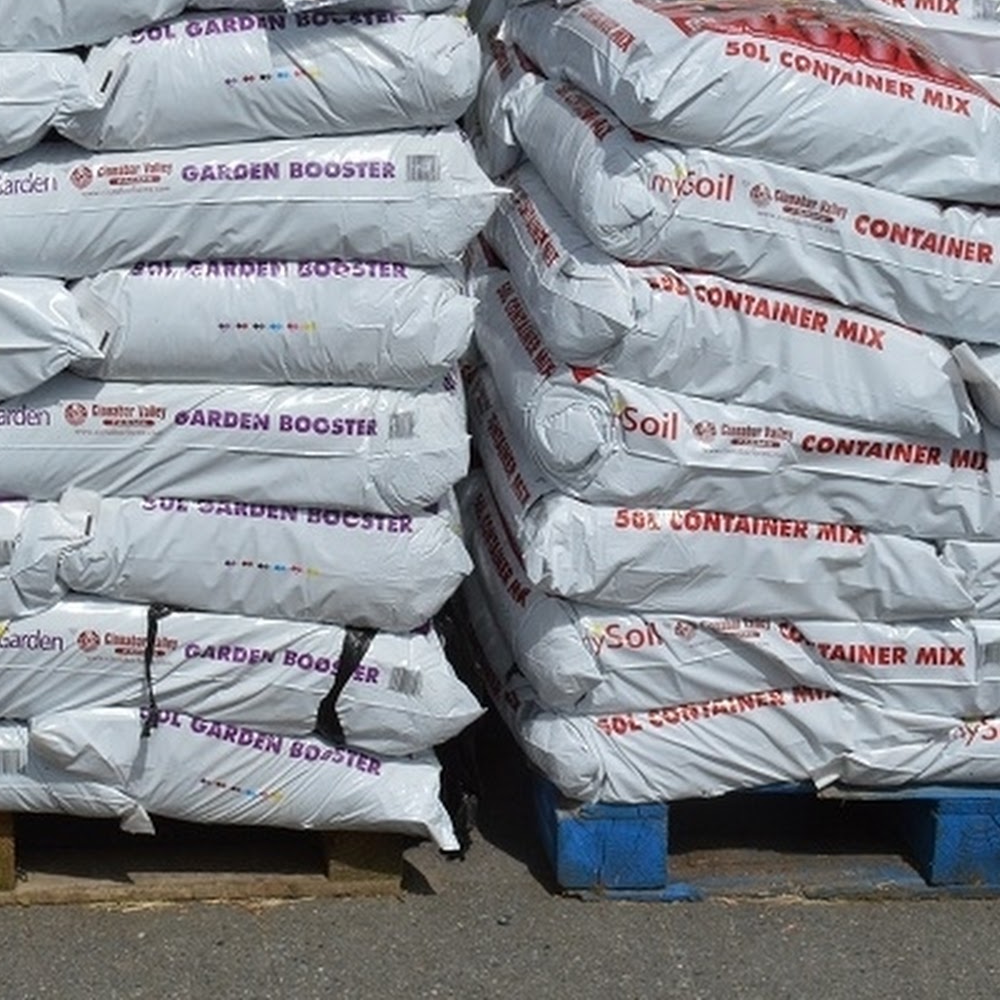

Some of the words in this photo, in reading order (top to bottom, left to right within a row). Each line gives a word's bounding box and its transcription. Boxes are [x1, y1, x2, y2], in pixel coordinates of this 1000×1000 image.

[185, 13, 286, 38] GARDEN
[725, 41, 771, 63] 50L
[780, 51, 915, 102] CONTAINER
[922, 89, 972, 118] MIX
[181, 162, 280, 182] GARDEN
[289, 160, 396, 180] BOOSTER
[650, 172, 734, 203] mySoil
[853, 213, 994, 265] CONTAINER
[189, 260, 286, 279] GARDEN
[298, 260, 408, 280] BOOSTER
[694, 283, 828, 334] CONTAINER
[834, 318, 886, 351] MIX
[279, 413, 378, 437] BOOSTER
[620, 405, 678, 441] Soil
[801, 434, 942, 468] CONTAINER
[307, 507, 414, 534] BOOSTER
[670, 509, 809, 541] CONTAINER
[818, 523, 866, 546] MIX
[184, 643, 275, 665] GARDEN
[283, 649, 380, 684] BOOSER
[915, 645, 965, 667] MIX
[648, 692, 786, 730] CONTAINER
[190, 714, 285, 755] GARDEN
[289, 738, 383, 776] BOOSTER
